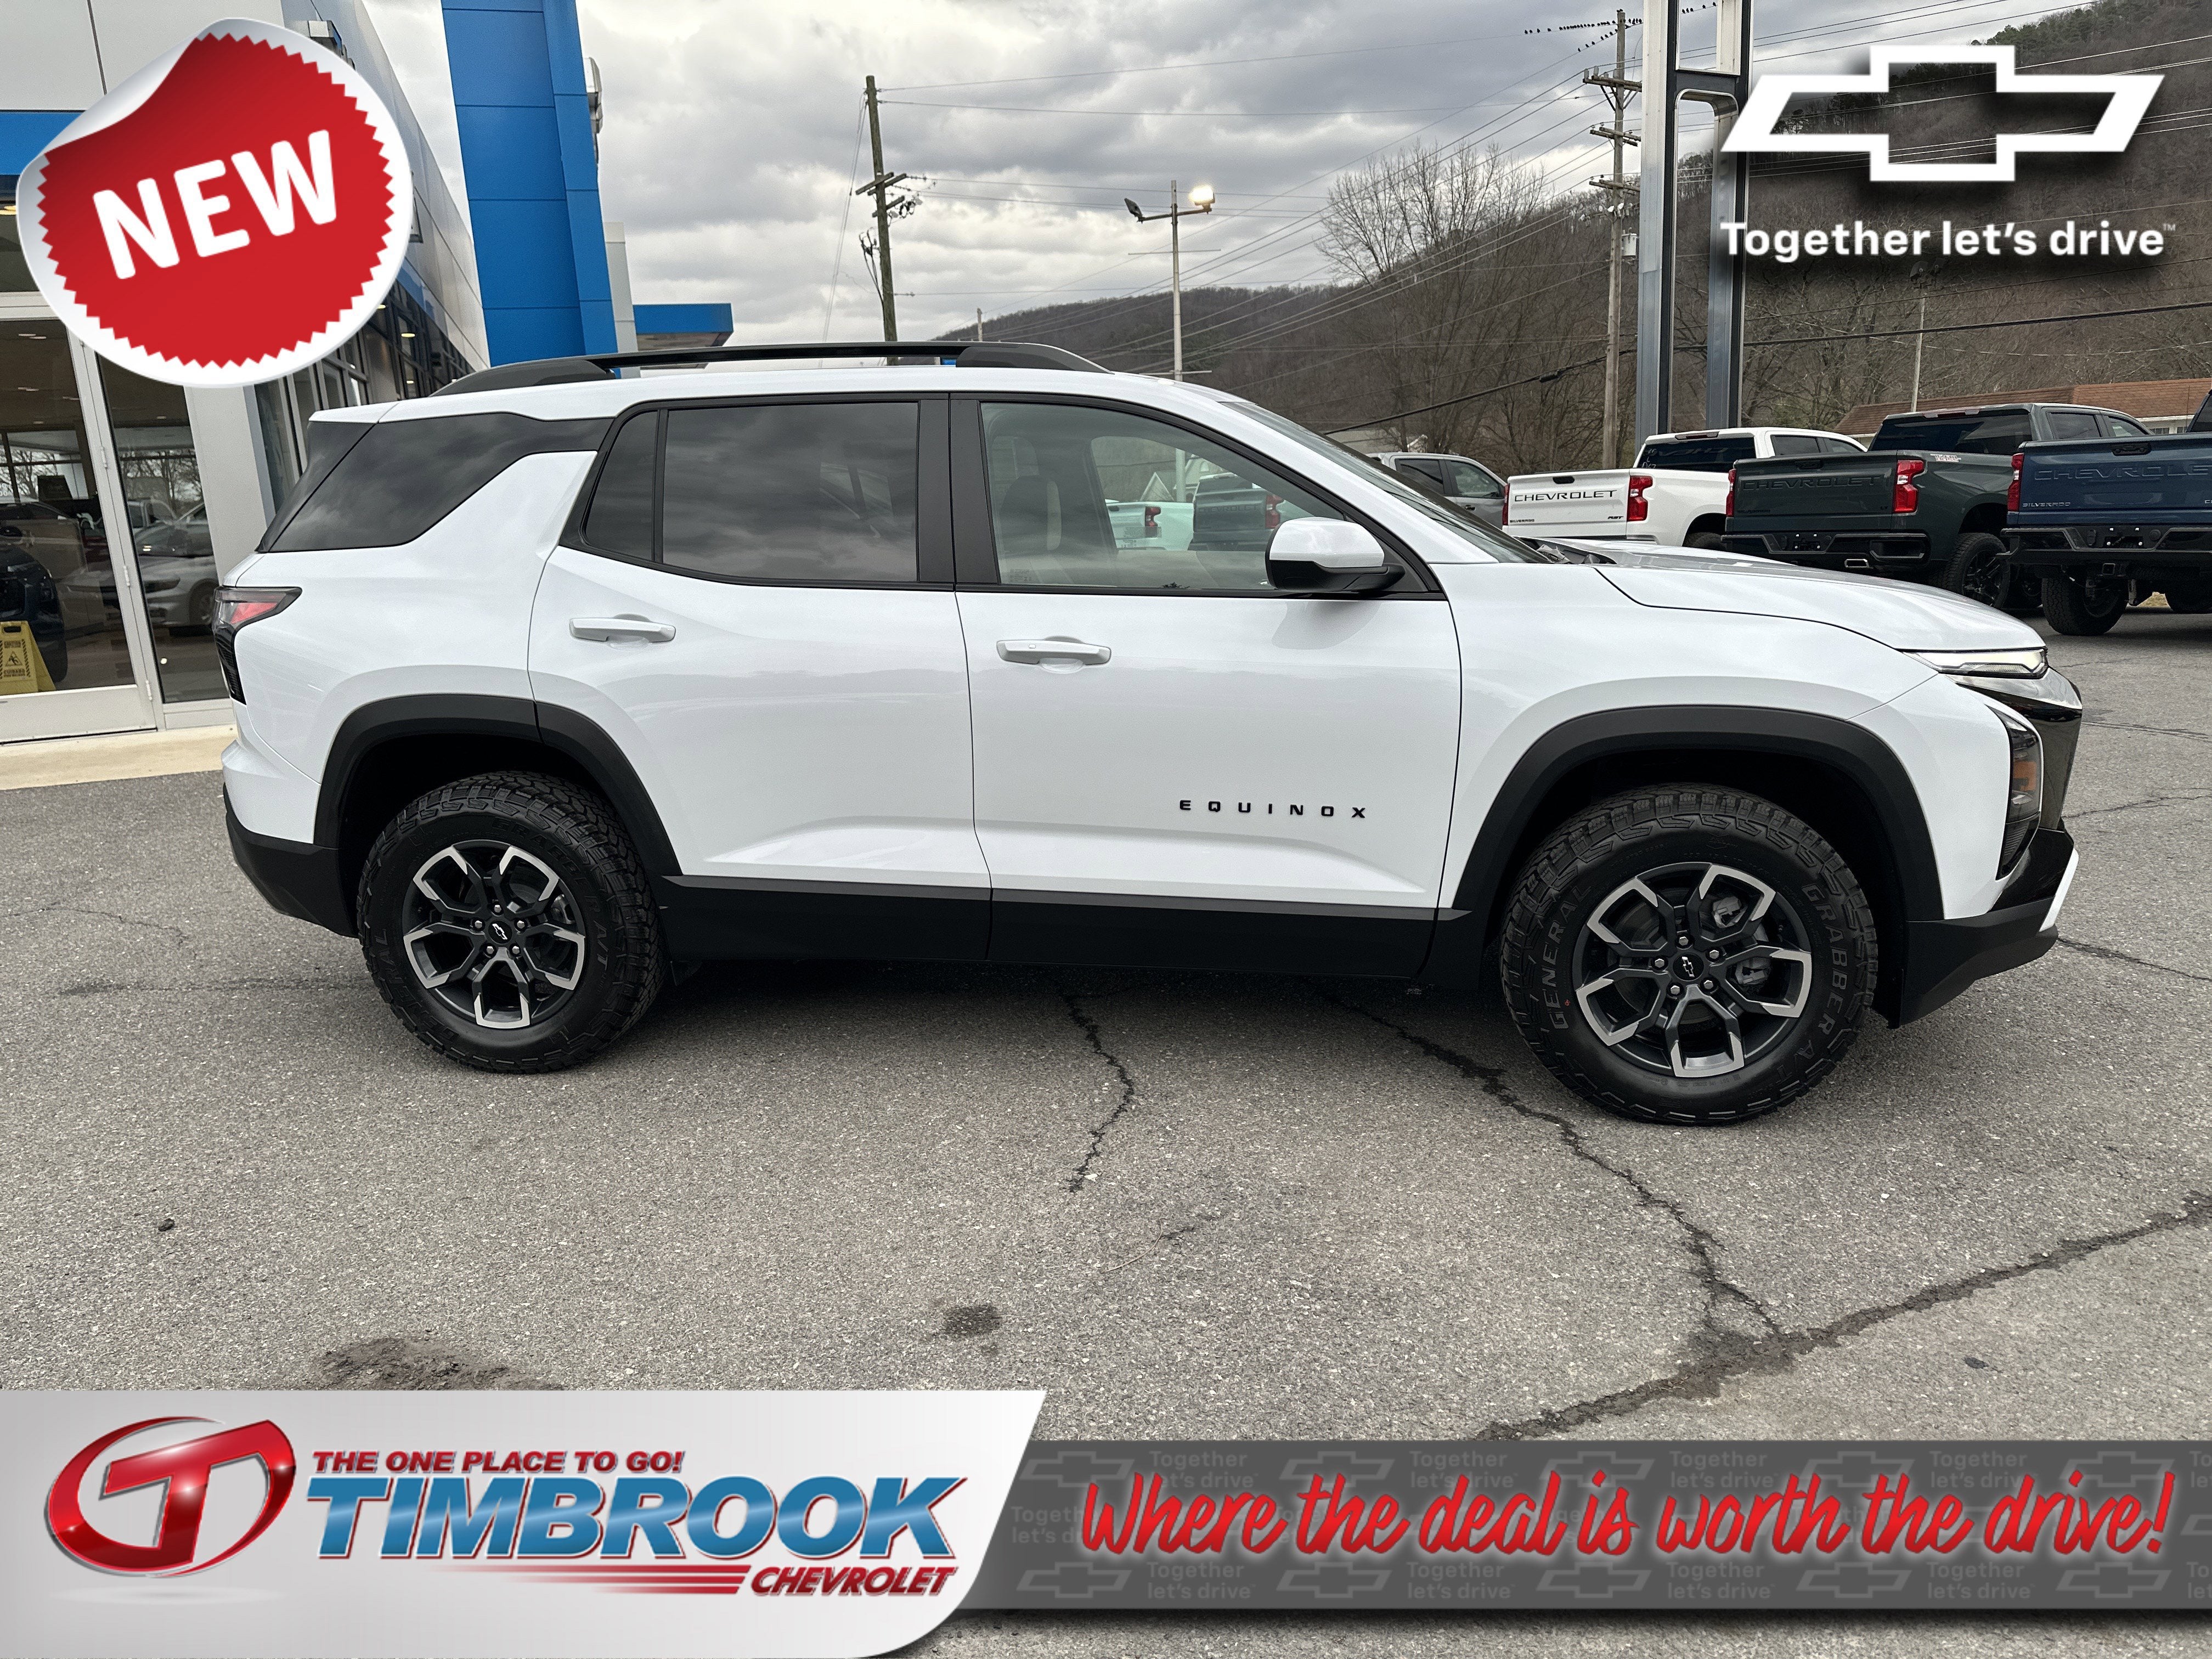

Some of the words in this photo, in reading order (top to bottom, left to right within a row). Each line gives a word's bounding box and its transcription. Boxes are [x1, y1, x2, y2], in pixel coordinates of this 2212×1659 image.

[2034, 465, 2212, 481] CHEVROLE
[1742, 476, 1881, 490] CHEVROLET
[1514, 489, 1617, 502] CHEVROLET
[1179, 799, 1366, 819] EQUINOX
[1540, 885, 1591, 1030] GENERAL
[1802, 883, 1849, 1036] GRABBER
